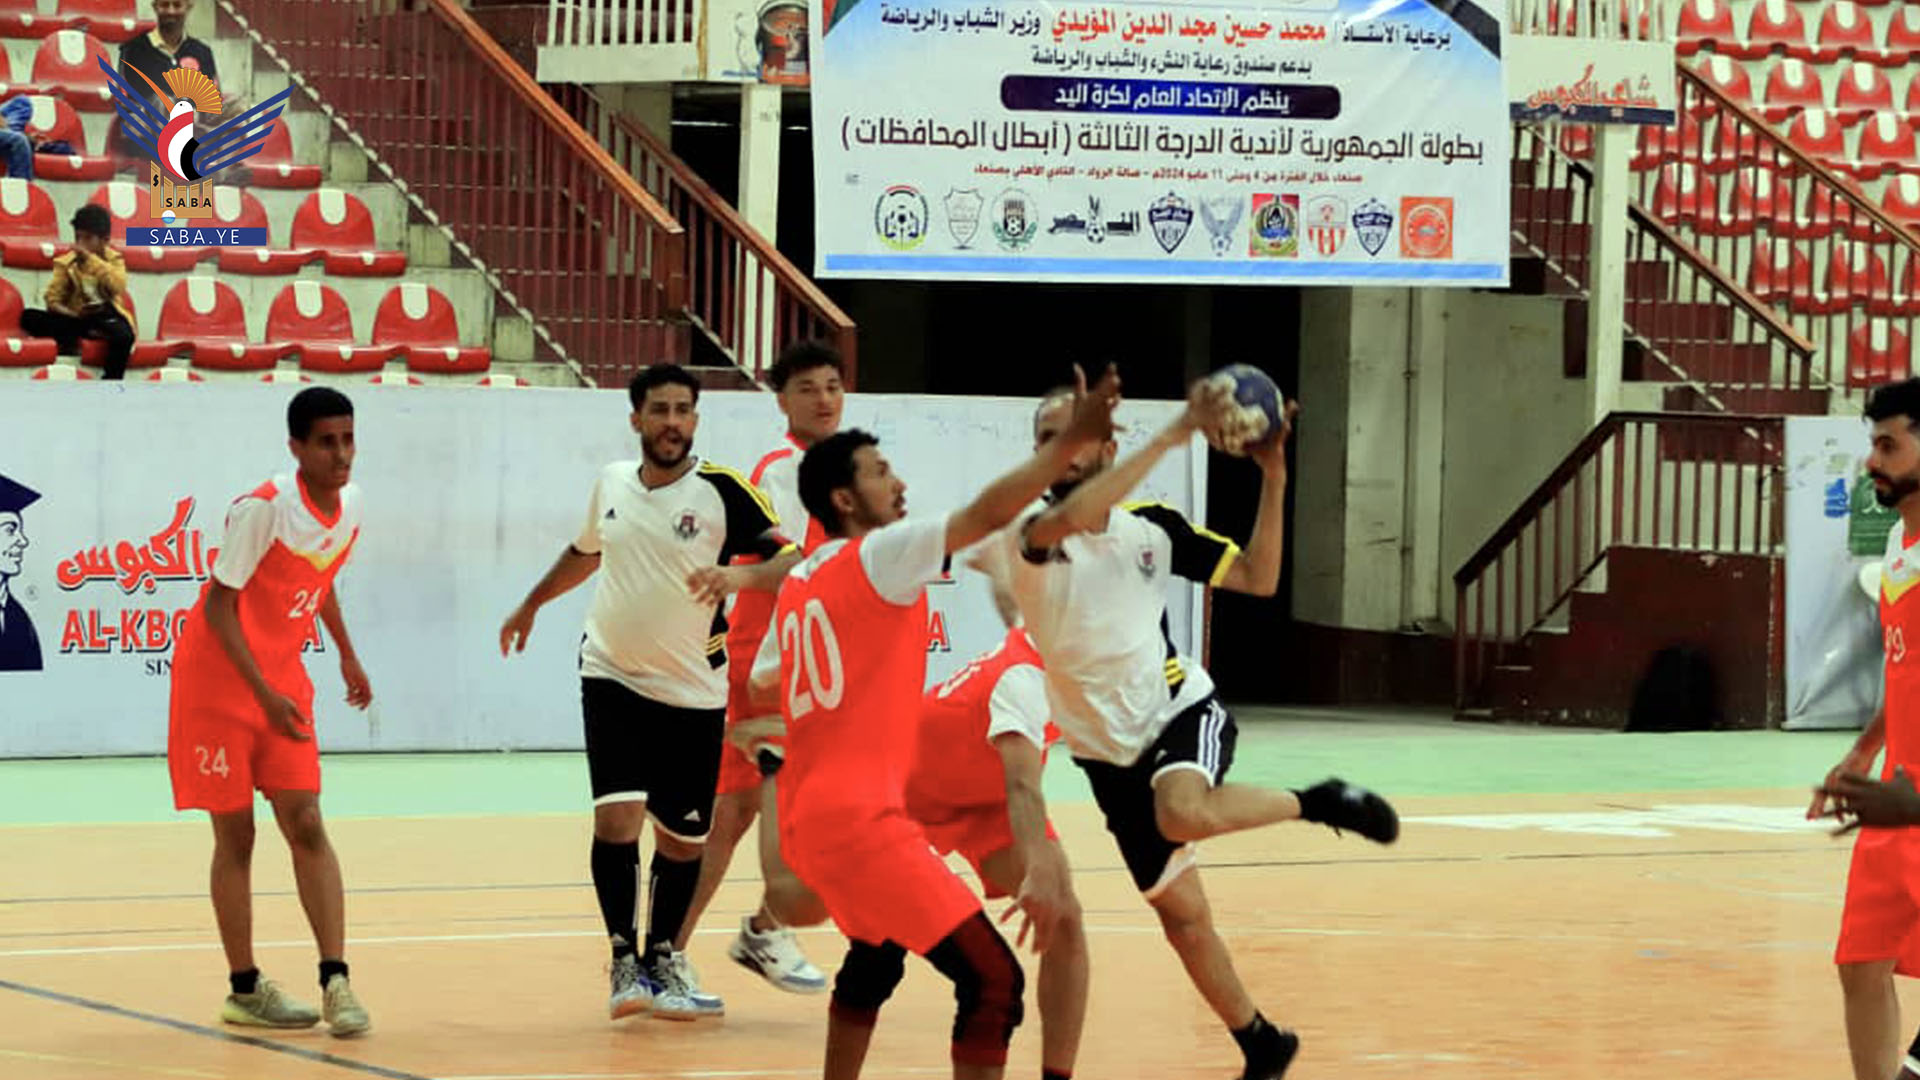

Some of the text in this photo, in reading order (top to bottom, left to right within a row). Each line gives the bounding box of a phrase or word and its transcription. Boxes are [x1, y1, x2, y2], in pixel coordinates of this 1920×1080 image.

[881, 3, 948, 31] والرياضة
[953, 7, 1005, 30] الشباب
[1009, 10, 1041, 36] وزير
[1052, 8, 1116, 42] المؤيدي
[1121, 10, 1173, 43] الدين
[1178, 15, 1218, 43] مجد
[1223, 14, 1272, 47] حسين
[1279, 20, 1327, 41] محمد
[1404, 24, 1452, 51] برعاية
[1032, 45, 1091, 70] والرياضة
[1095, 47, 1148, 71] والشباب
[1194, 51, 1230, 76] رعاية
[1233, 55, 1276, 77] صندوق
[1279, 60, 1312, 79] بدعم
[1055, 83, 1088, 107] اليد
[1092, 83, 1131, 108] لكرة
[1134, 86, 1182, 110] العام
[1241, 90, 1290, 115] ينظم
[1077, 121, 1150, 152] الثالثة
[1156, 126, 1223, 159] الدرجة
[1230, 126, 1293, 160] لأندية
[1300, 128, 1413, 163] الجمهورية
[1421, 131, 1484, 165] بطولة
[288, 586, 322, 618] 24
[781, 598, 845, 721] 20
[195, 745, 230, 779] 24
